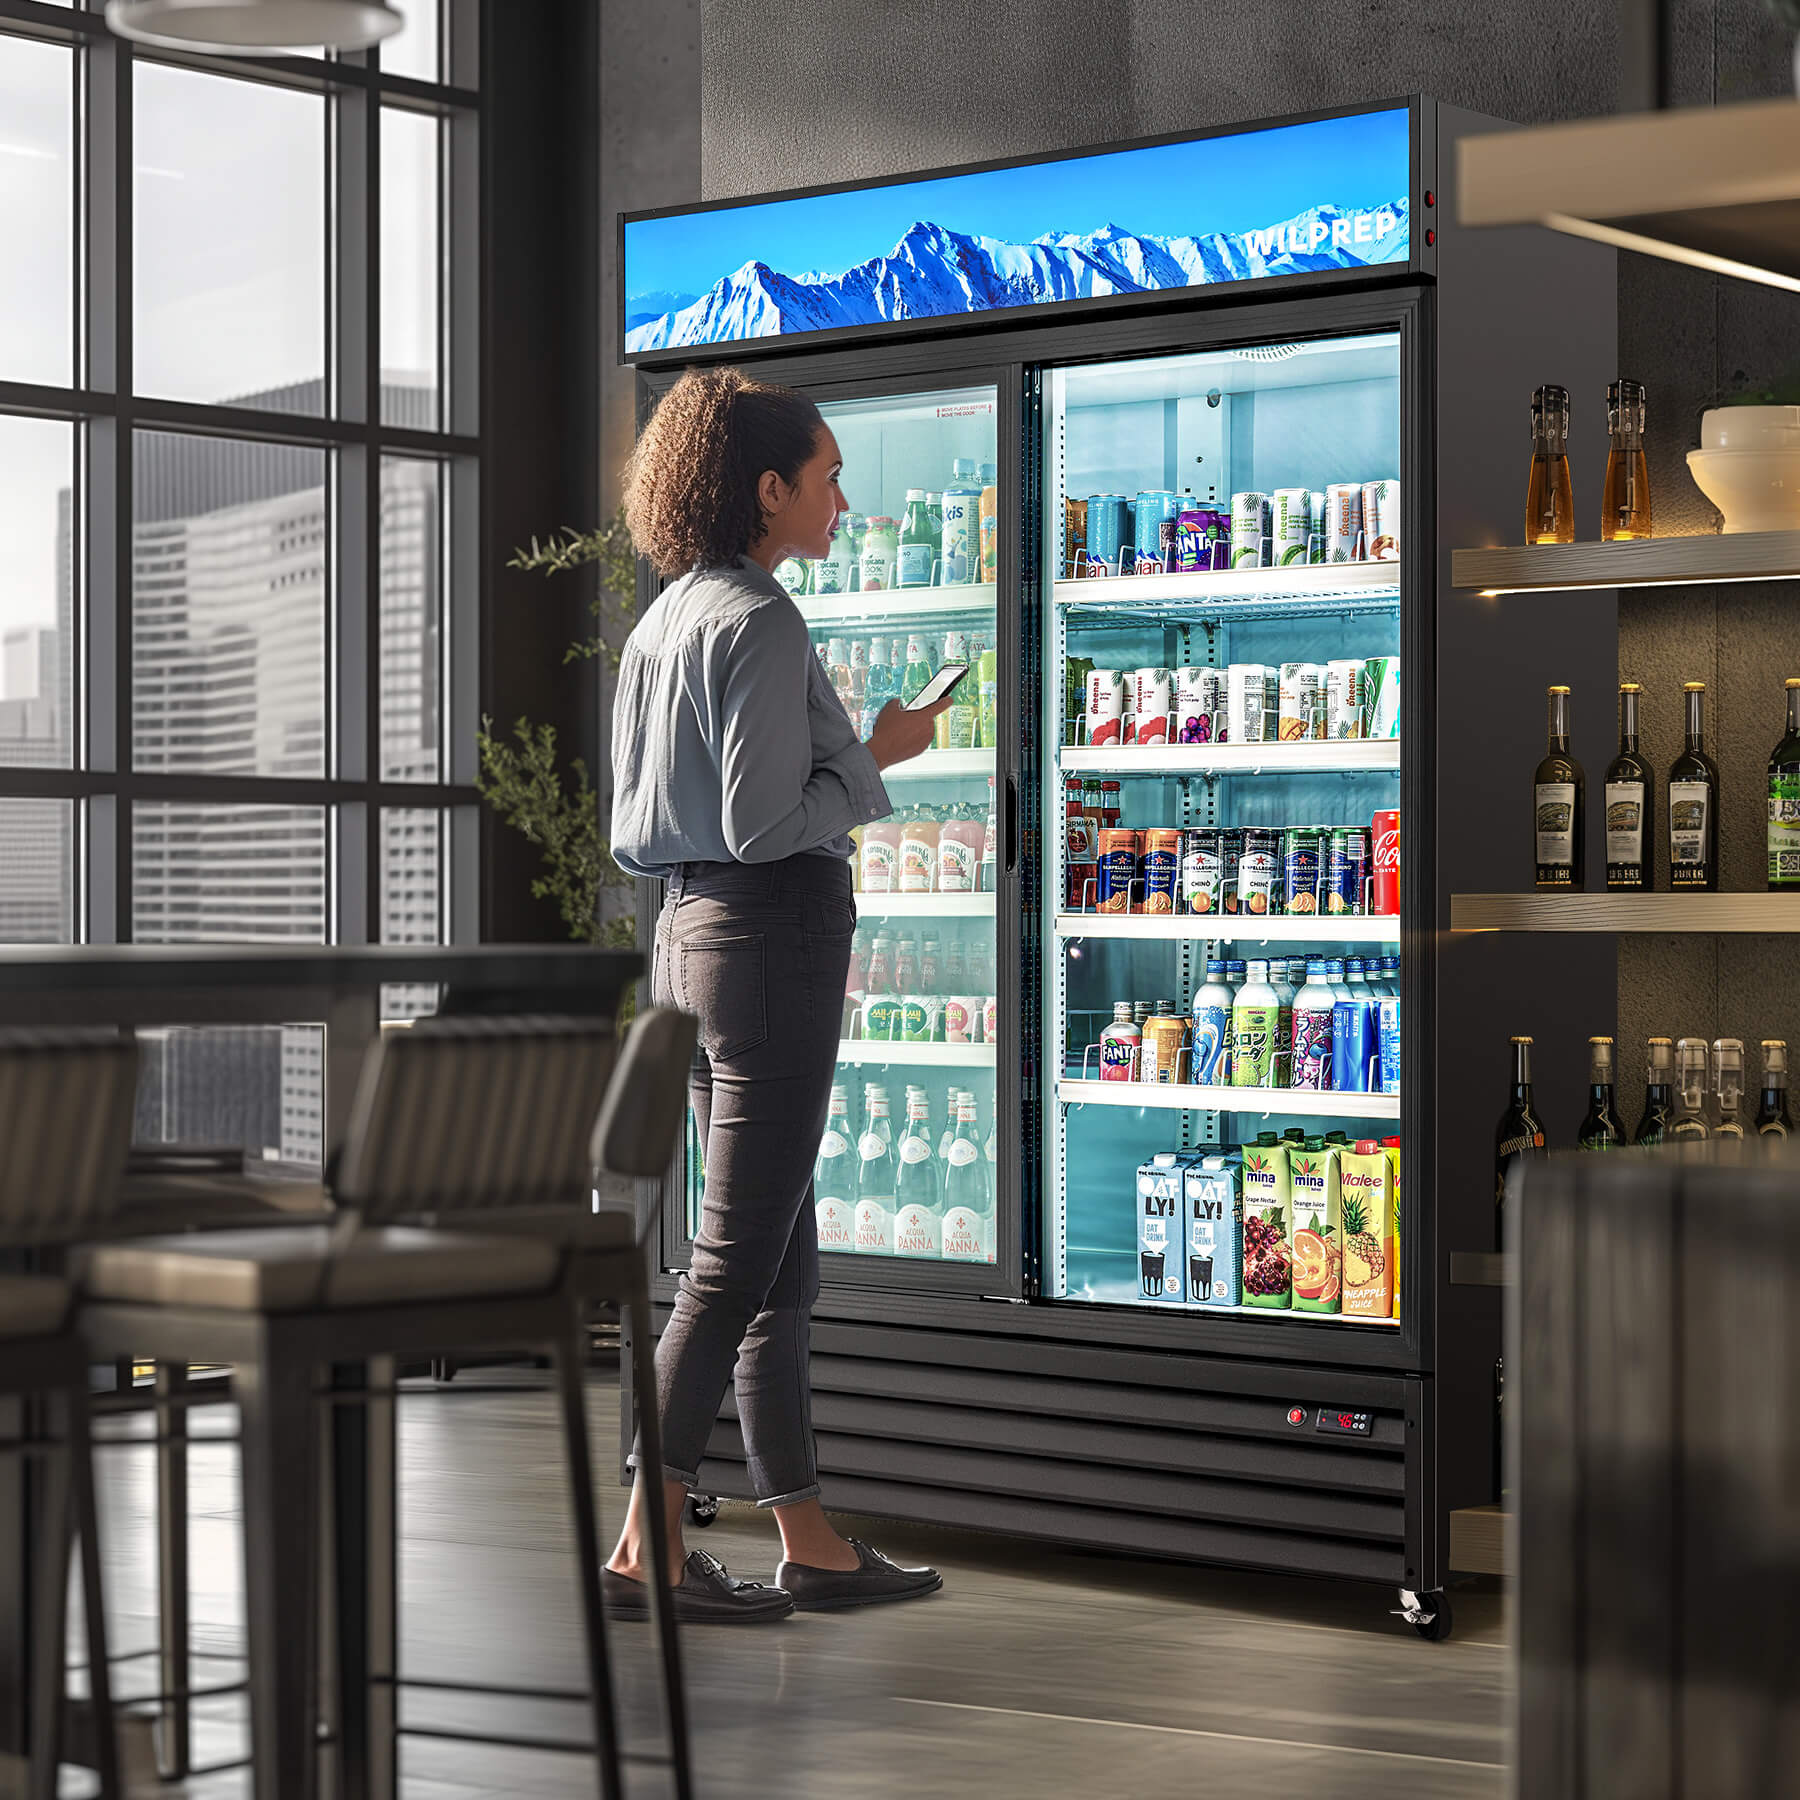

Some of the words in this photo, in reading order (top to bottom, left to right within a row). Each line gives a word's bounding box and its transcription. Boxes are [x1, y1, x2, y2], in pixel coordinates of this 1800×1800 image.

[1246, 213, 1397, 258] WILPREP
[944, 505, 963, 521] kis
[1176, 533, 1212, 554] ANTA
[1087, 563, 1108, 577] ian
[1135, 560, 1163, 575] vian
[1102, 1044, 1132, 1062] FANT
[1246, 1170, 1276, 1184] mina
[1295, 1174, 1324, 1188] mina
[1341, 1172, 1383, 1188] Malee
[1145, 1197, 1175, 1217] LY!
[1245, 1196, 1259, 1205] Grape
[1294, 1200, 1312, 1209] Orange
[1193, 1200, 1223, 1220] LY!
[822, 1221, 841, 1229] ACQUA
[860, 1223, 876, 1231] ACQUA
[905, 1228, 925, 1236] ACQUA
[1146, 1223, 1158, 1233] OAT
[1194, 1227, 1206, 1236] OAT
[855, 1231, 886, 1246] ANNA
[951, 1231, 971, 1239] ACQUA
[1146, 1232, 1164, 1242] DRINK
[1194, 1236, 1212, 1246] DRINK
[898, 1235, 933, 1250] PANNA
[944, 1238, 980, 1253] PANNA
[1350, 1300, 1373, 1308] JUICE
[1338, 1413, 1353, 1428] 46
